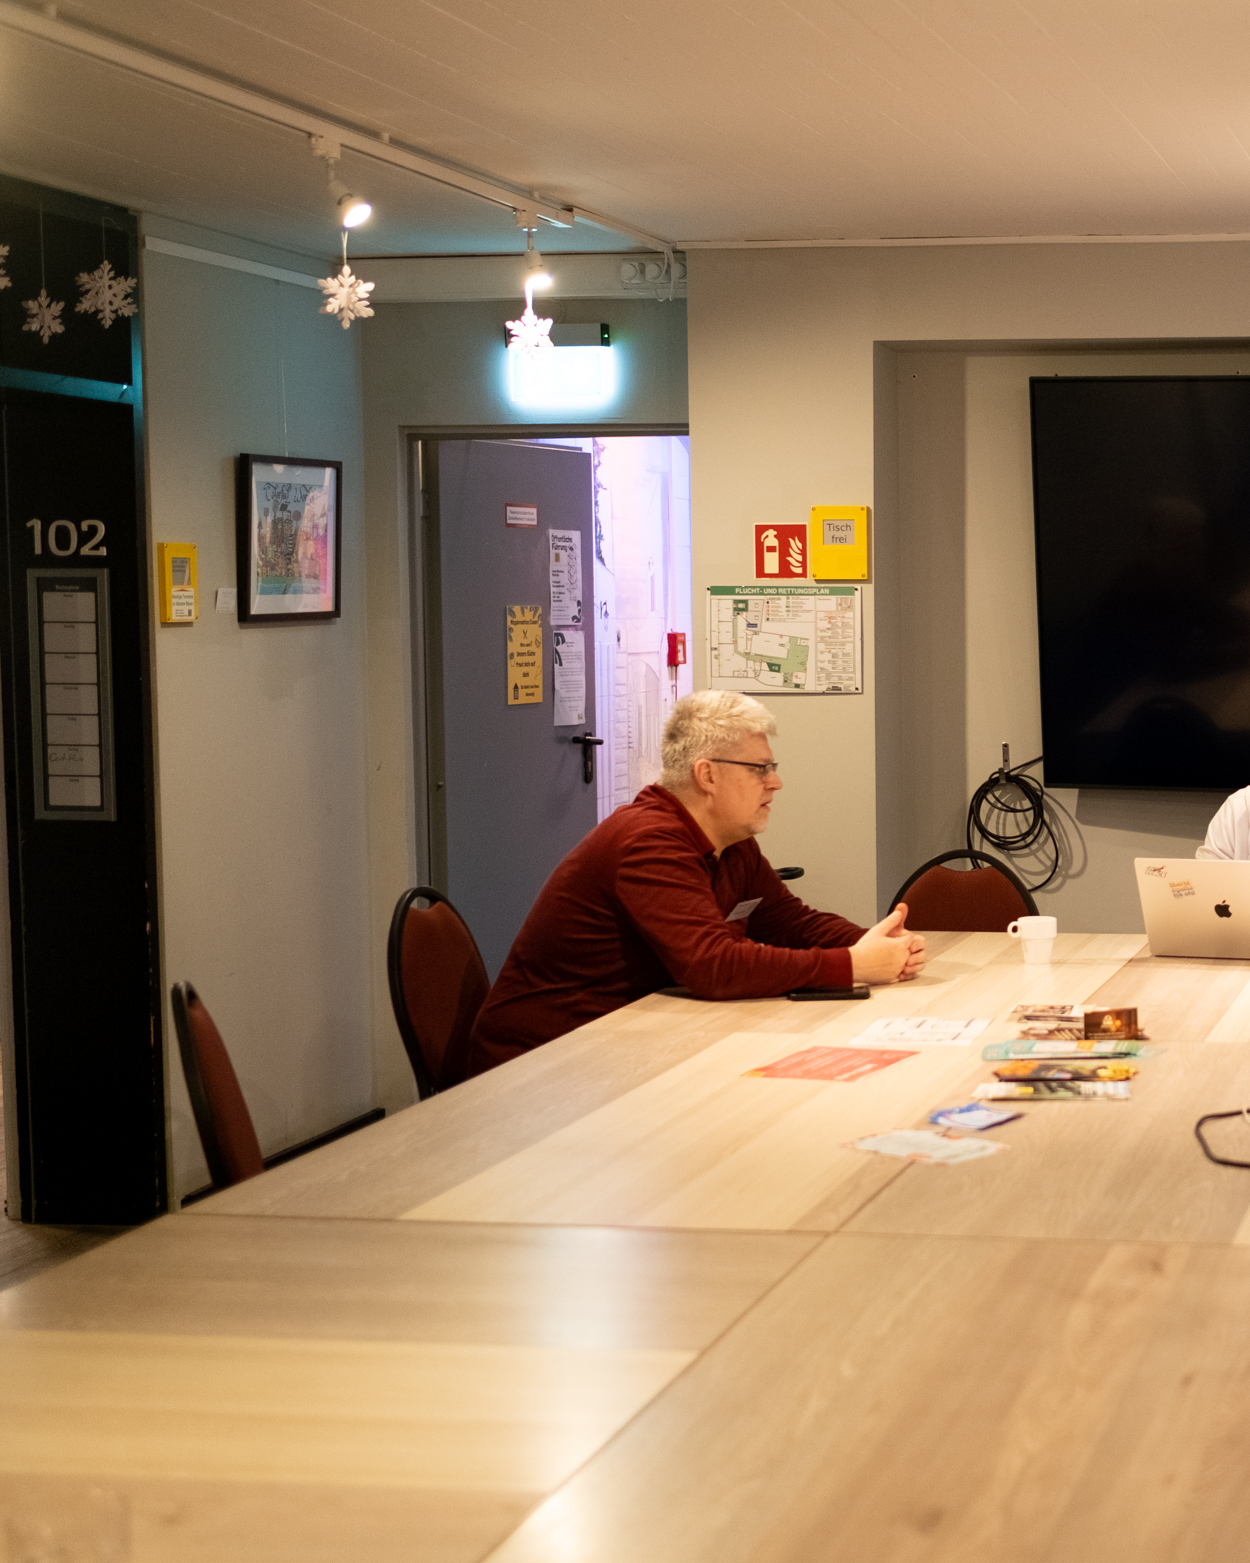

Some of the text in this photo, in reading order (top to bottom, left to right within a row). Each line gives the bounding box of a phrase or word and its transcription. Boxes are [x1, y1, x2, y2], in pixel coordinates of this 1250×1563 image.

[826, 522, 852, 532] Tisch
[25, 518, 107, 556] 102
[831, 534, 848, 544] frei
[735, 587, 764, 595] FLUCHT-
[765, 587, 777, 595] UND
